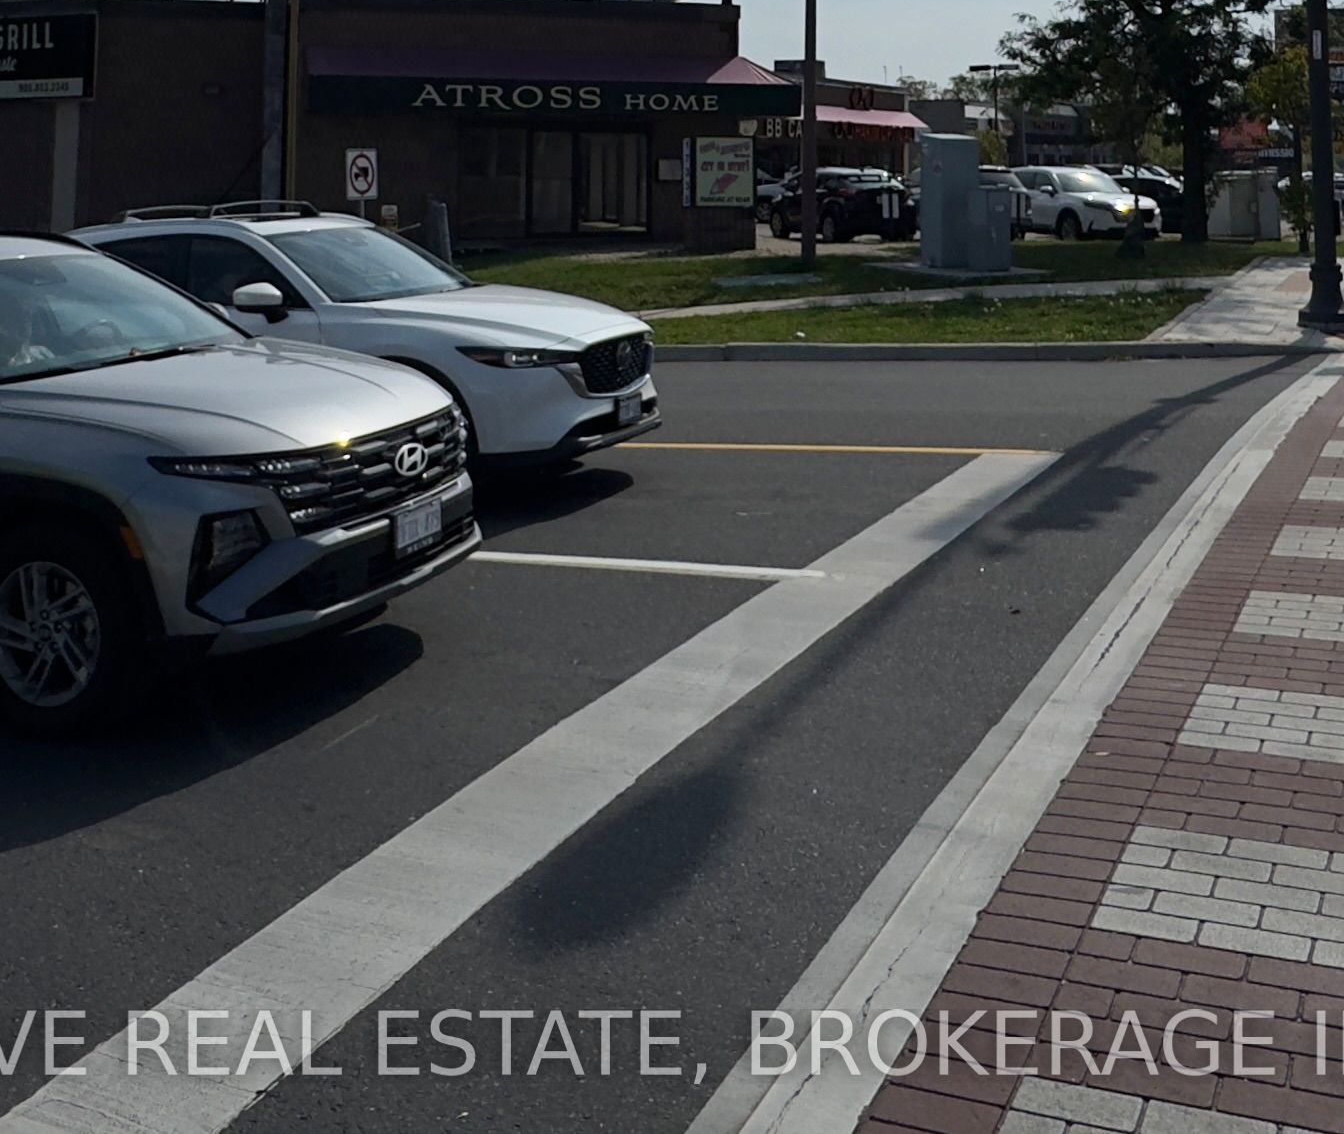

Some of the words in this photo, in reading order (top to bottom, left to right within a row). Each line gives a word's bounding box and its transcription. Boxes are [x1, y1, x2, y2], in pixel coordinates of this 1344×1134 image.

[412, 83, 602, 110] ATROSS
[624, 93, 719, 111] HOME
[766, 118, 782, 138] BB
